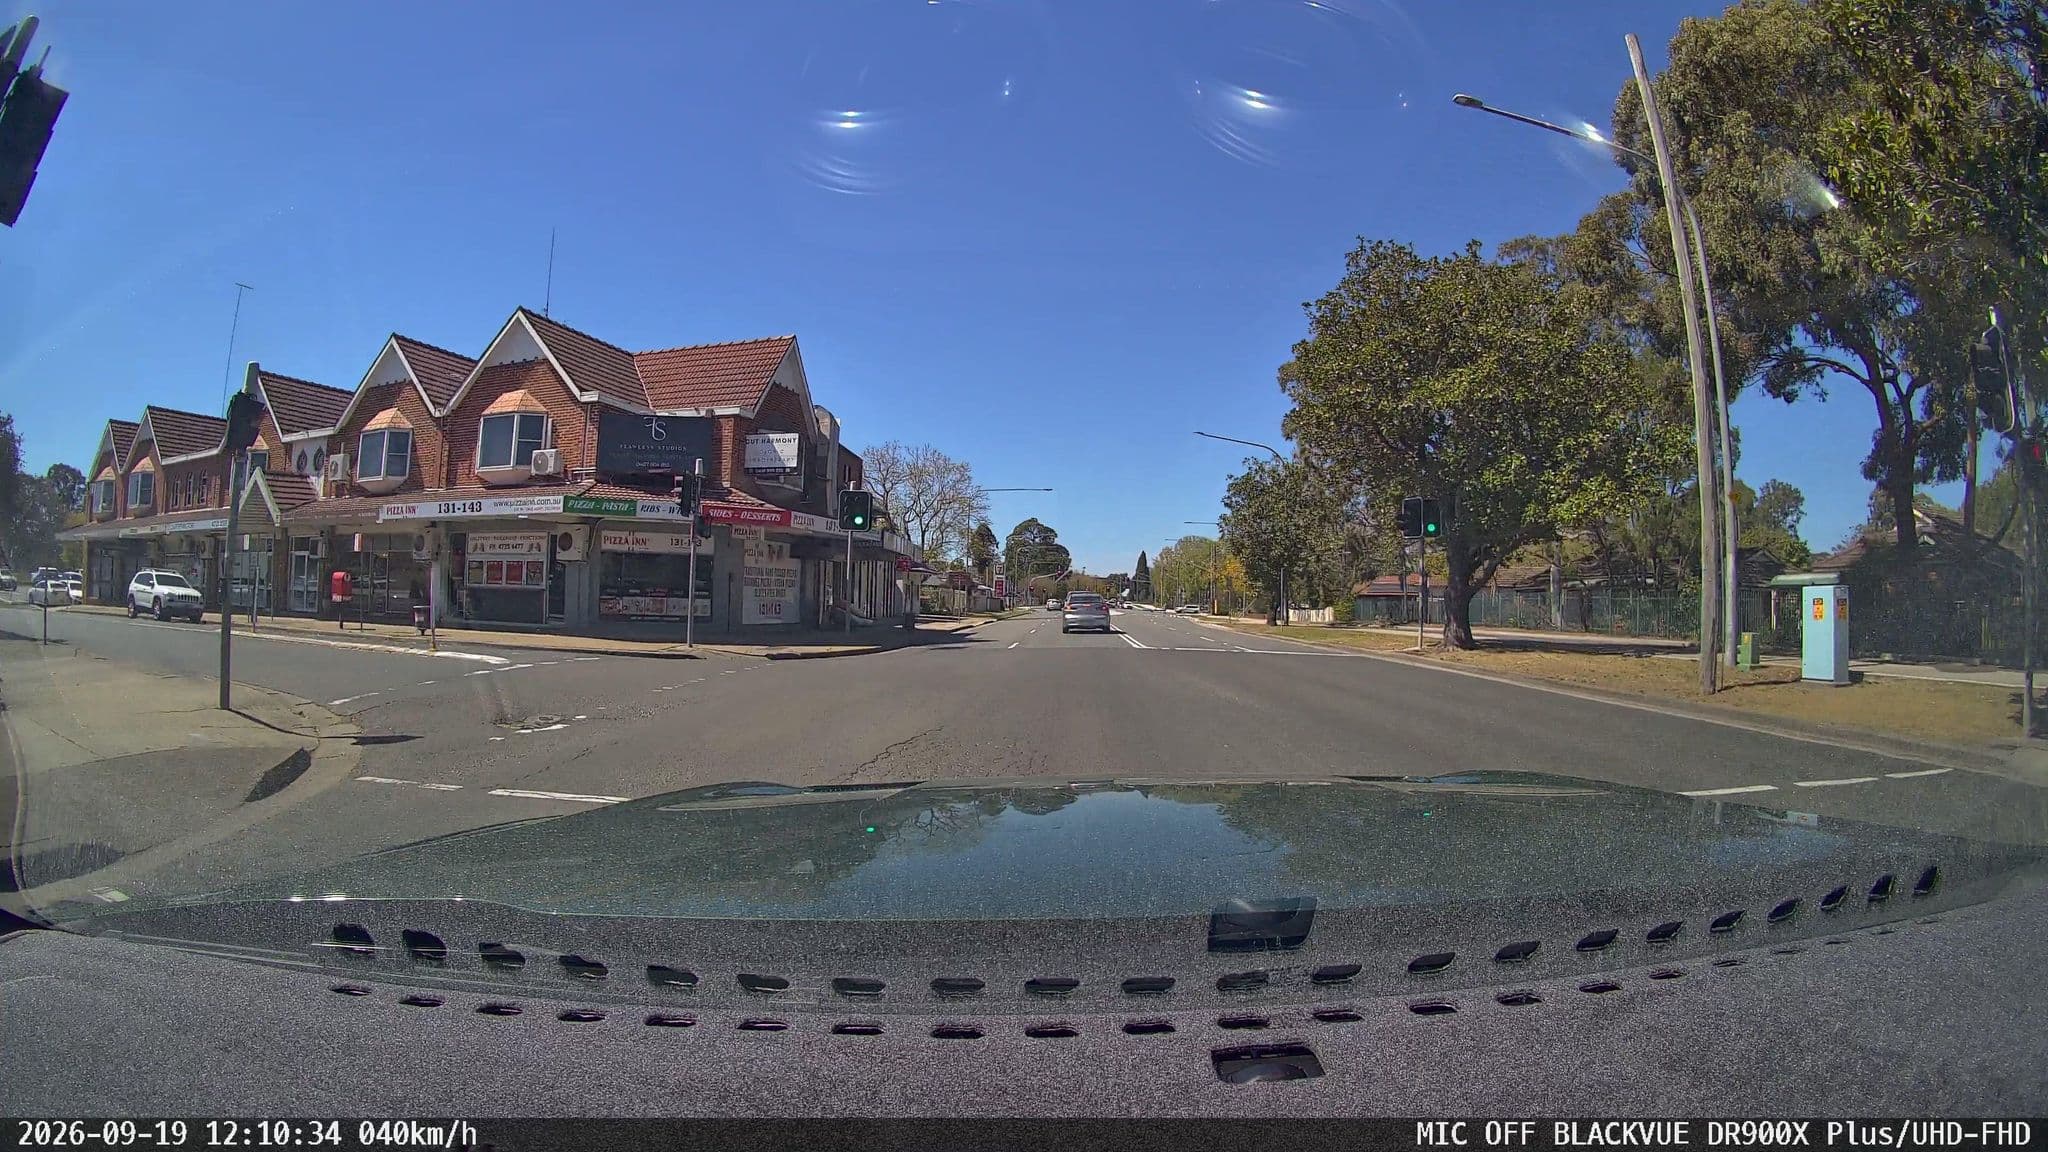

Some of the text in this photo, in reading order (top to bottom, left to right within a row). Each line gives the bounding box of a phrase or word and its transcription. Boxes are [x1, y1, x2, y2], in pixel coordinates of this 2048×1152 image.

[386, 505, 417, 516] PIZZA INN
[438, 501, 482, 514] 131-143
[567, 500, 629, 511] PIZZA PASTA
[640, 504, 661, 513] RIBS
[708, 508, 782, 522] SIDES DESSERTS
[733, 528, 748, 536] PIZZA
[603, 535, 647, 547] PIZZA INN
[670, 538, 702, 547] 131-13
